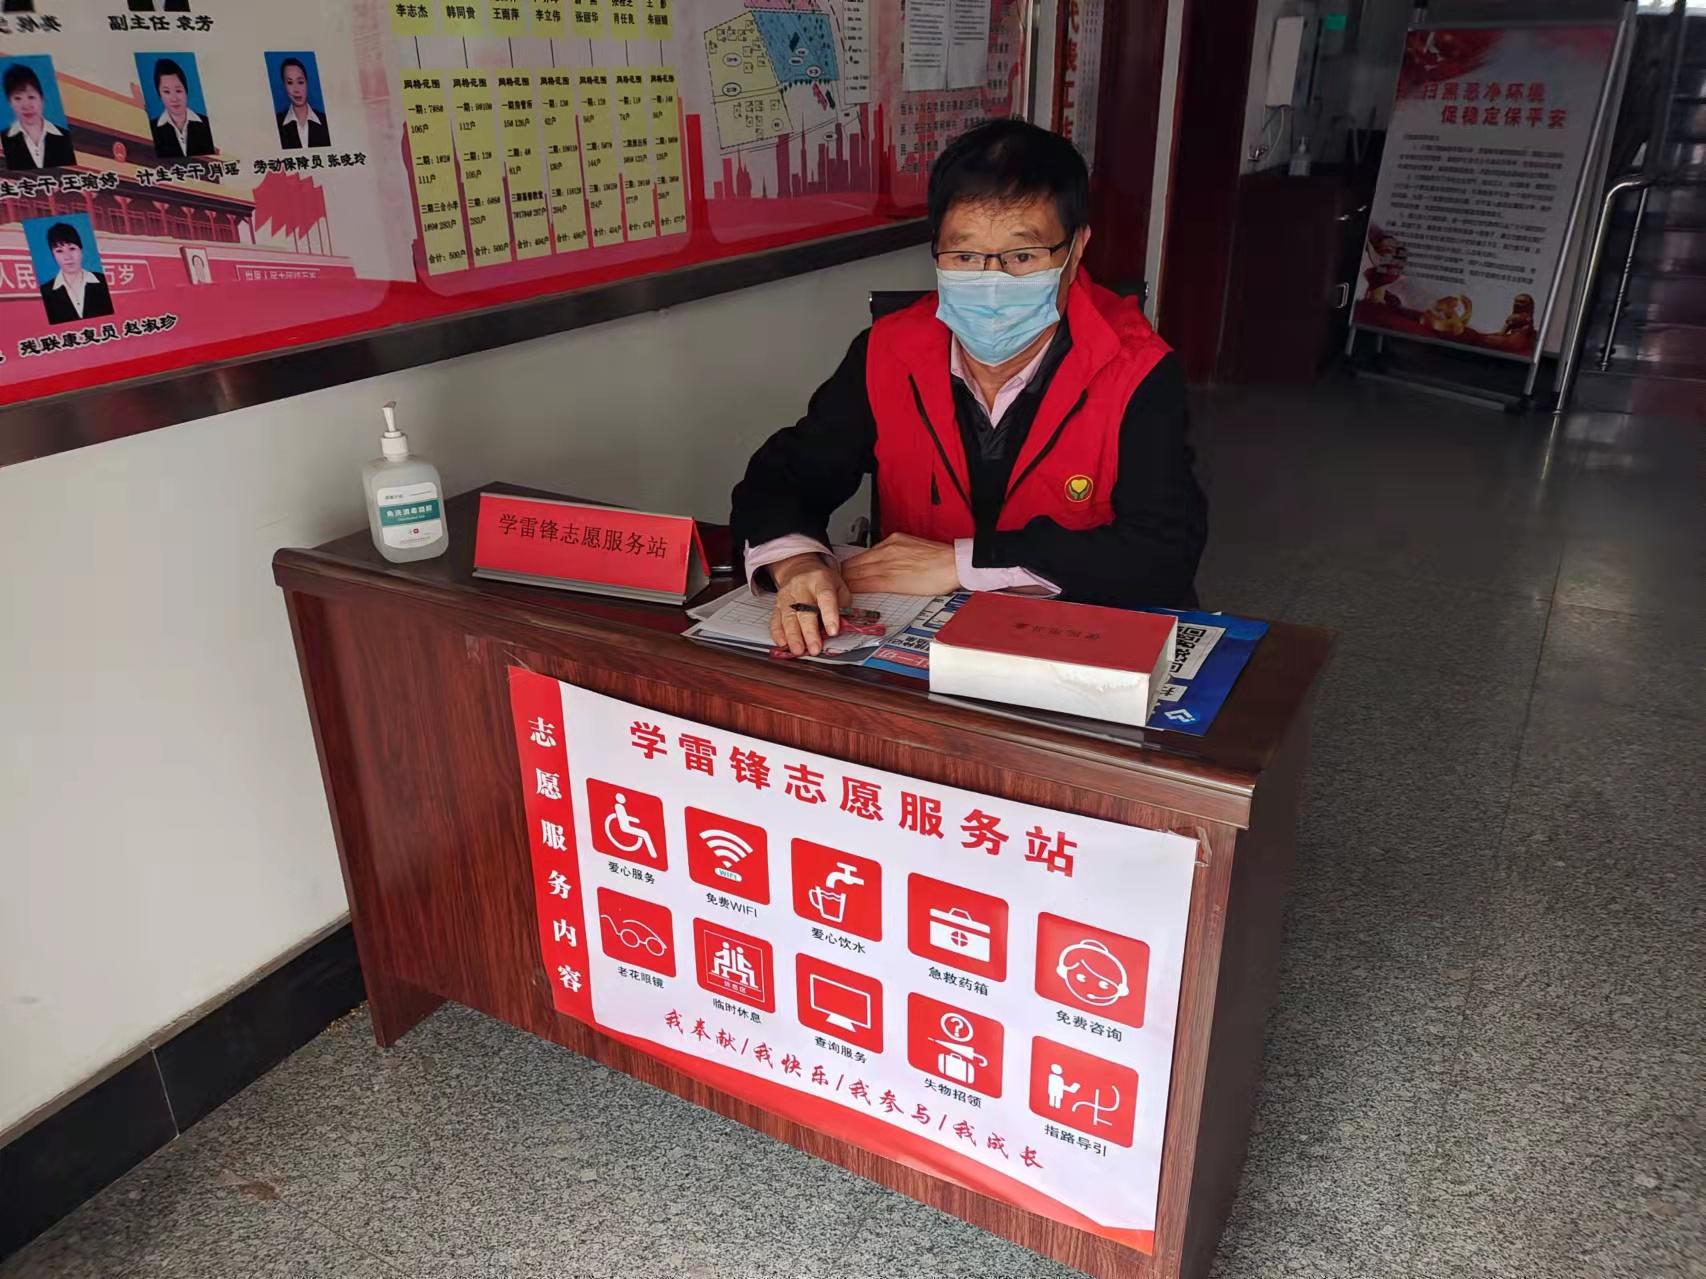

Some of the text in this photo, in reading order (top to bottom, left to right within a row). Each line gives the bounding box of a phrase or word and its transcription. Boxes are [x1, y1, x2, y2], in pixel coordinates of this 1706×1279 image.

[108, 15, 213, 31] 副主任 袁芳
[136, 165, 204, 185] 计生专干
[254, 152, 367, 173] 劳动保障员 张晓玲
[20, 324, 120, 356] 残联康复员
[124, 314, 178, 337] 赵淑珍
[498, 512, 668, 560] 学雷锋志愿服务站
[629, 720, 1079, 878] 学雷锋志愿服务站
[527, 716, 583, 994] 志愿服务内容
[607, 860, 656, 885] 爱心服务
[706, 892, 758, 918] 免费WIFI
[811, 926, 866, 954] 爱心饮水
[617, 965, 664, 989] 老花眼镜
[928, 966, 989, 997] 急救药箱
[712, 997, 762, 1024] 临时休息
[1056, 1009, 1123, 1043] 免费咨询
[814, 1036, 867, 1064] 查询服务
[924, 1077, 982, 1109] 失物招领
[1044, 1123, 1108, 1157] 指路导引
